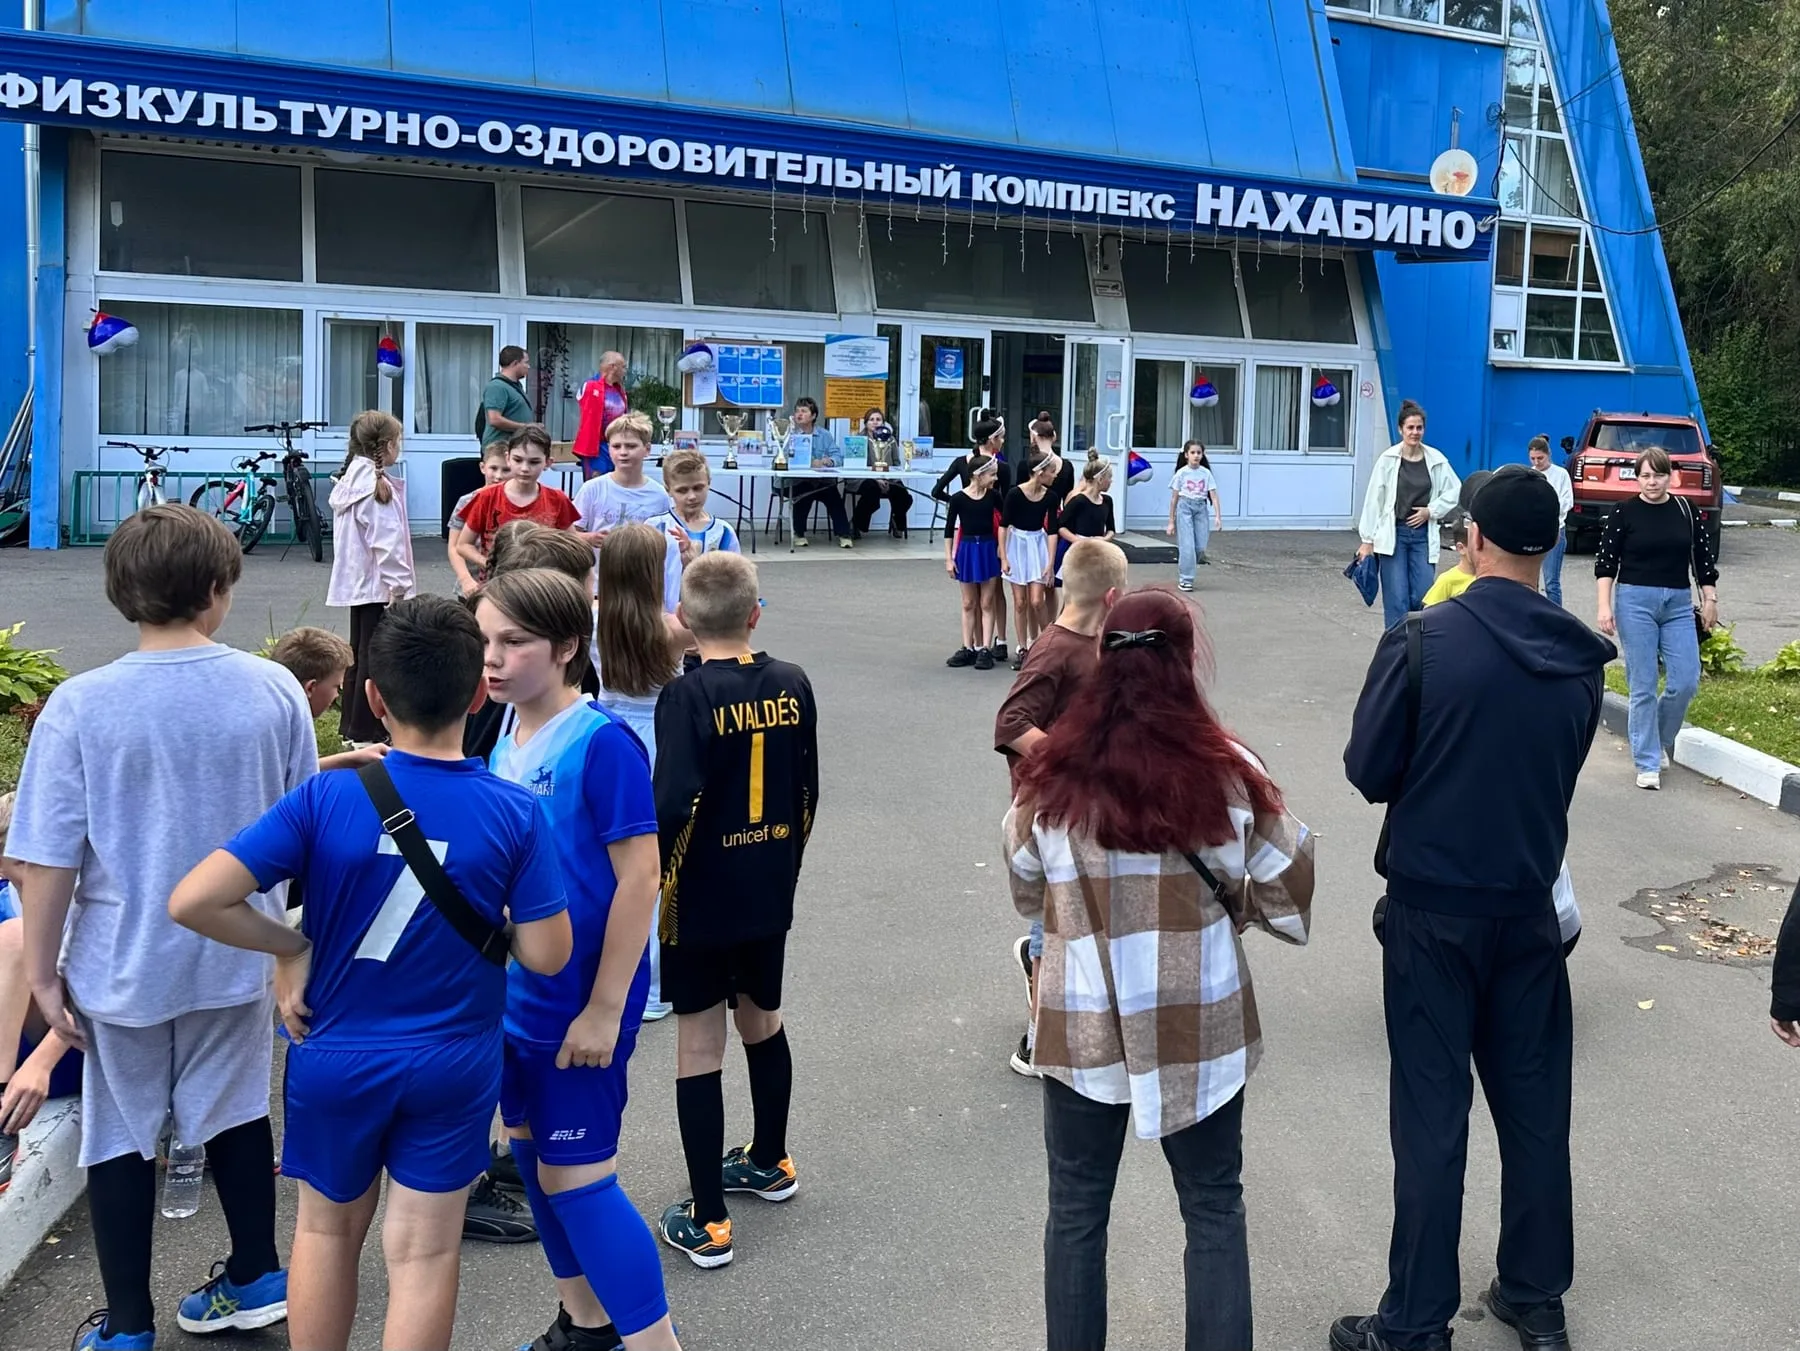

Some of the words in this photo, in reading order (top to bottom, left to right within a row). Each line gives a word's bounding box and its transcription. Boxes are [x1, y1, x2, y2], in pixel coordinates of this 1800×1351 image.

[0, 72, 961, 199] ФИЗКУЛЬТУРНО-ОЗДОРОВИТЕЛЬНЫЙ
[971, 172, 1175, 221] КОМПЛЕКС
[1196, 182, 1477, 250] НАХАБИНО
[713, 690, 800, 736] V.VALDÉS
[749, 732, 765, 824] 1
[722, 825, 769, 848] unicef
[354, 833, 449, 962] 7
